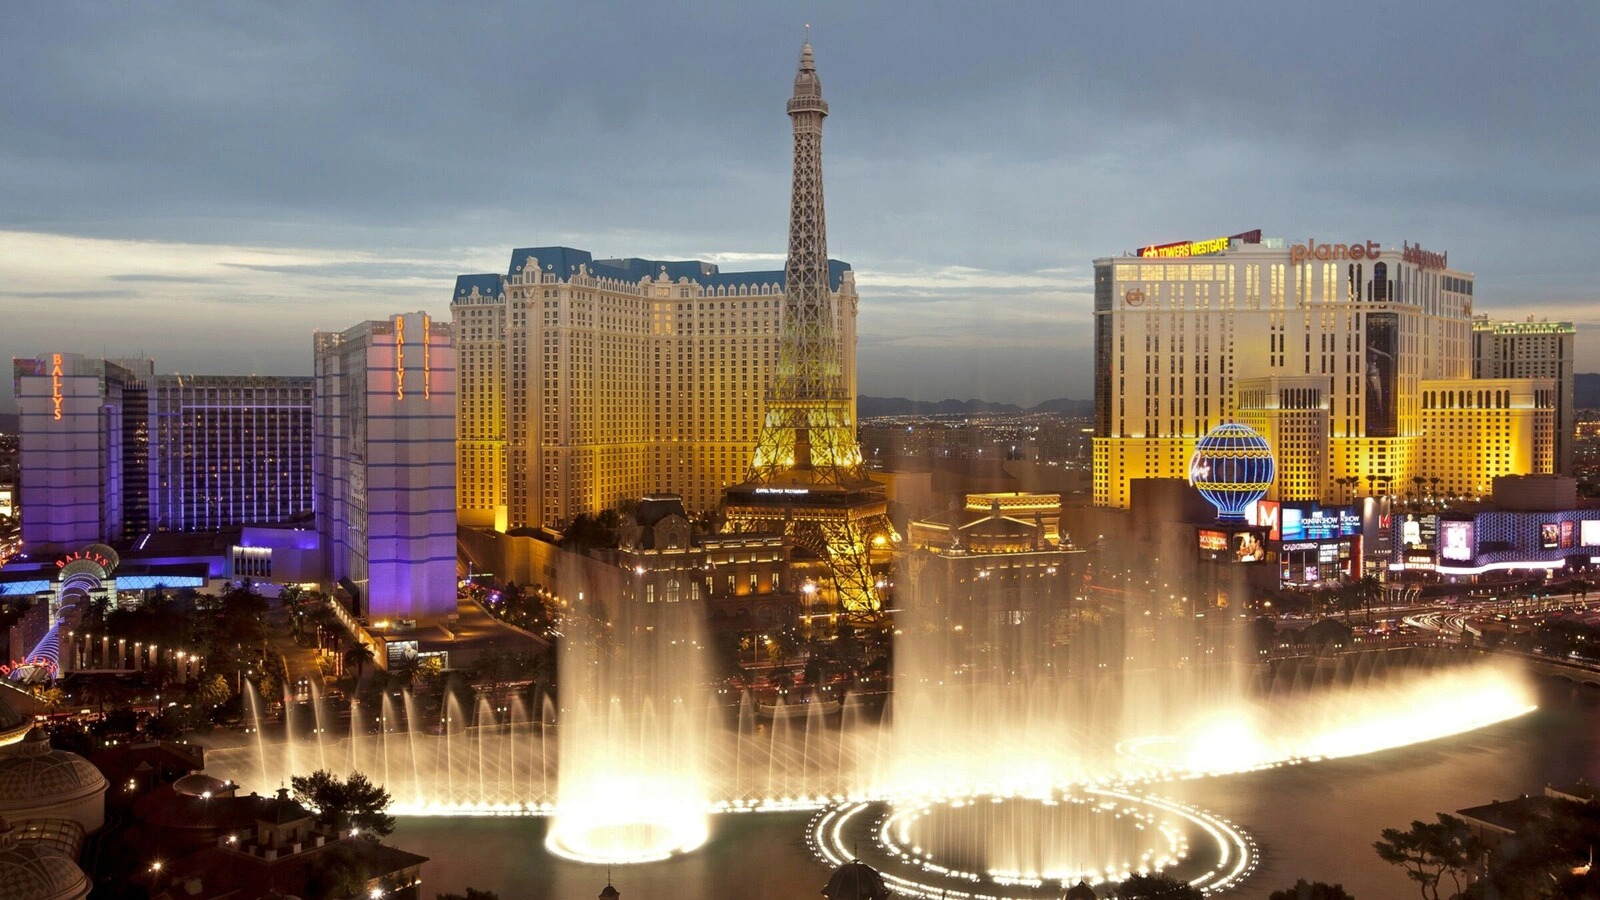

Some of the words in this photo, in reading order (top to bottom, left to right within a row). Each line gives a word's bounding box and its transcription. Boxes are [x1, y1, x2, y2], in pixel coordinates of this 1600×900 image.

[1159, 243, 1190, 258] TOWERS
[1190, 237, 1229, 256] WESTGATE
[1291, 238, 1381, 265] planet
[396, 315, 405, 401] BALLYS
[52, 353, 64, 421] BALLYS
[1260, 505, 1278, 531] M
[55, 551, 109, 568] BALLYS
